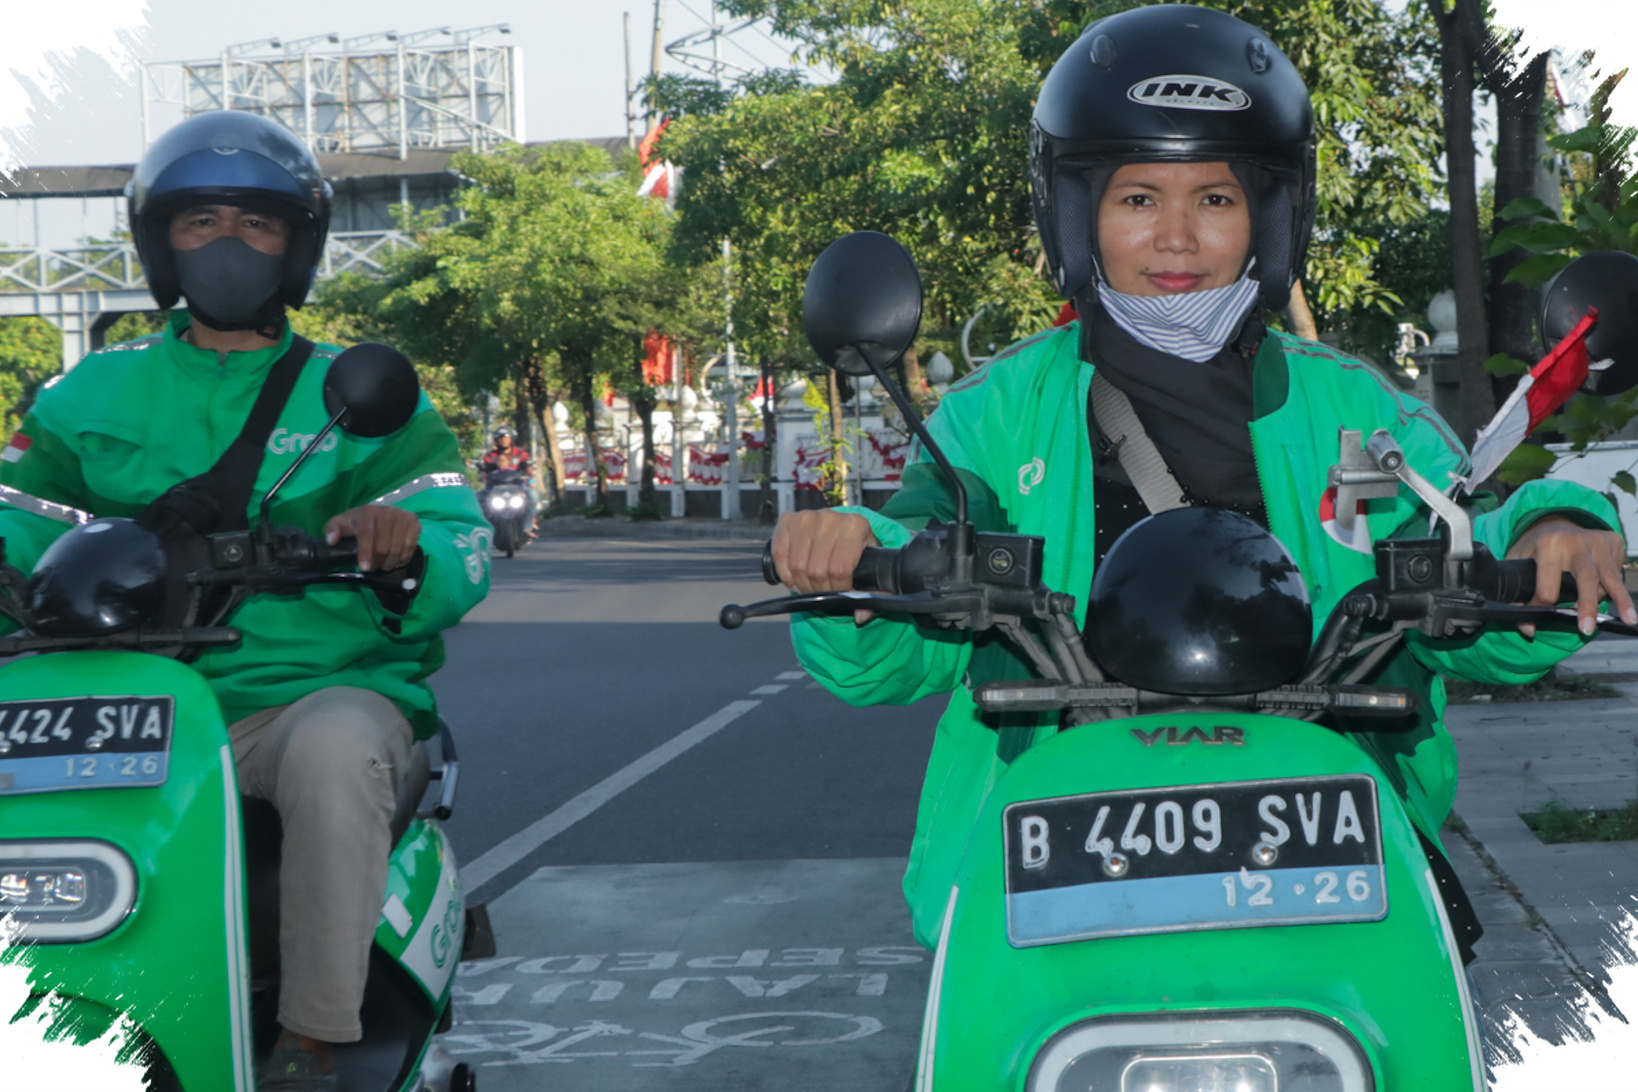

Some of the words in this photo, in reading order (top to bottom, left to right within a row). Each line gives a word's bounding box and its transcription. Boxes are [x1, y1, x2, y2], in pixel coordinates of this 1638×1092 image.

[1141, 82, 1238, 103] INK
[95, 704, 162, 739] SVA
[1129, 726, 1247, 746] VIAR
[1020, 815, 1050, 870] B
[1085, 798, 1223, 858] 4409
[1257, 790, 1366, 847] SVA
